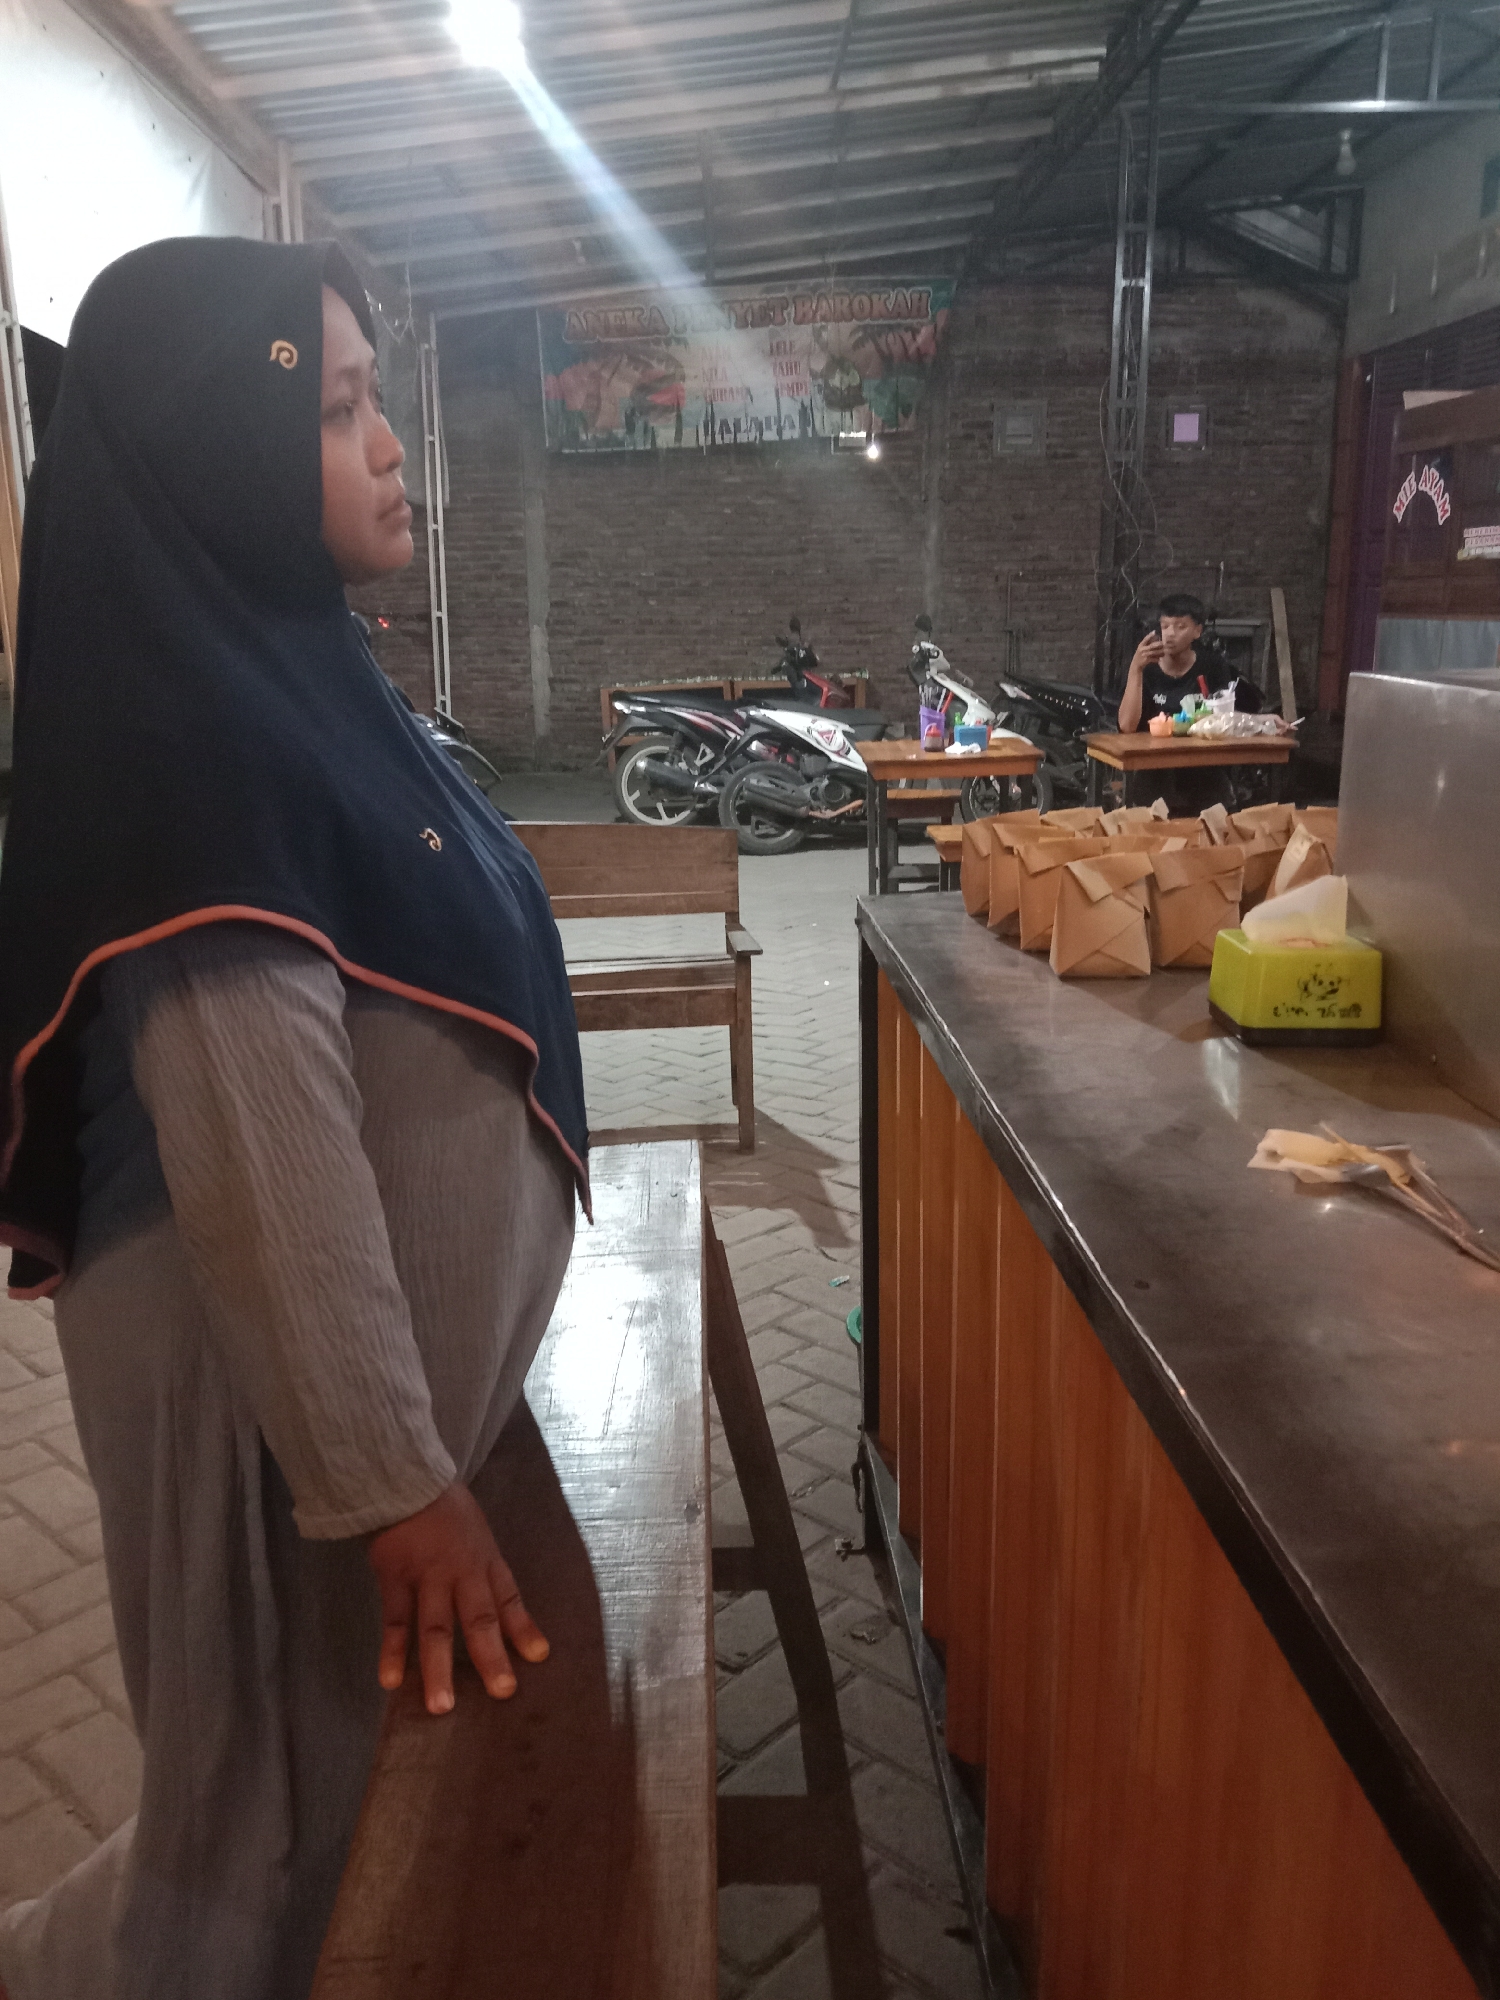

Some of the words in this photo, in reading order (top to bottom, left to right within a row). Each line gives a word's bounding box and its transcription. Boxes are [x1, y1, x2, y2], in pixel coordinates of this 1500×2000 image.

[564, 304, 672, 342] ANEKA
[792, 287, 931, 326] BAROKAH
[1393, 471, 1417, 523] MIE
[1418, 464, 1451, 525] AYAM
